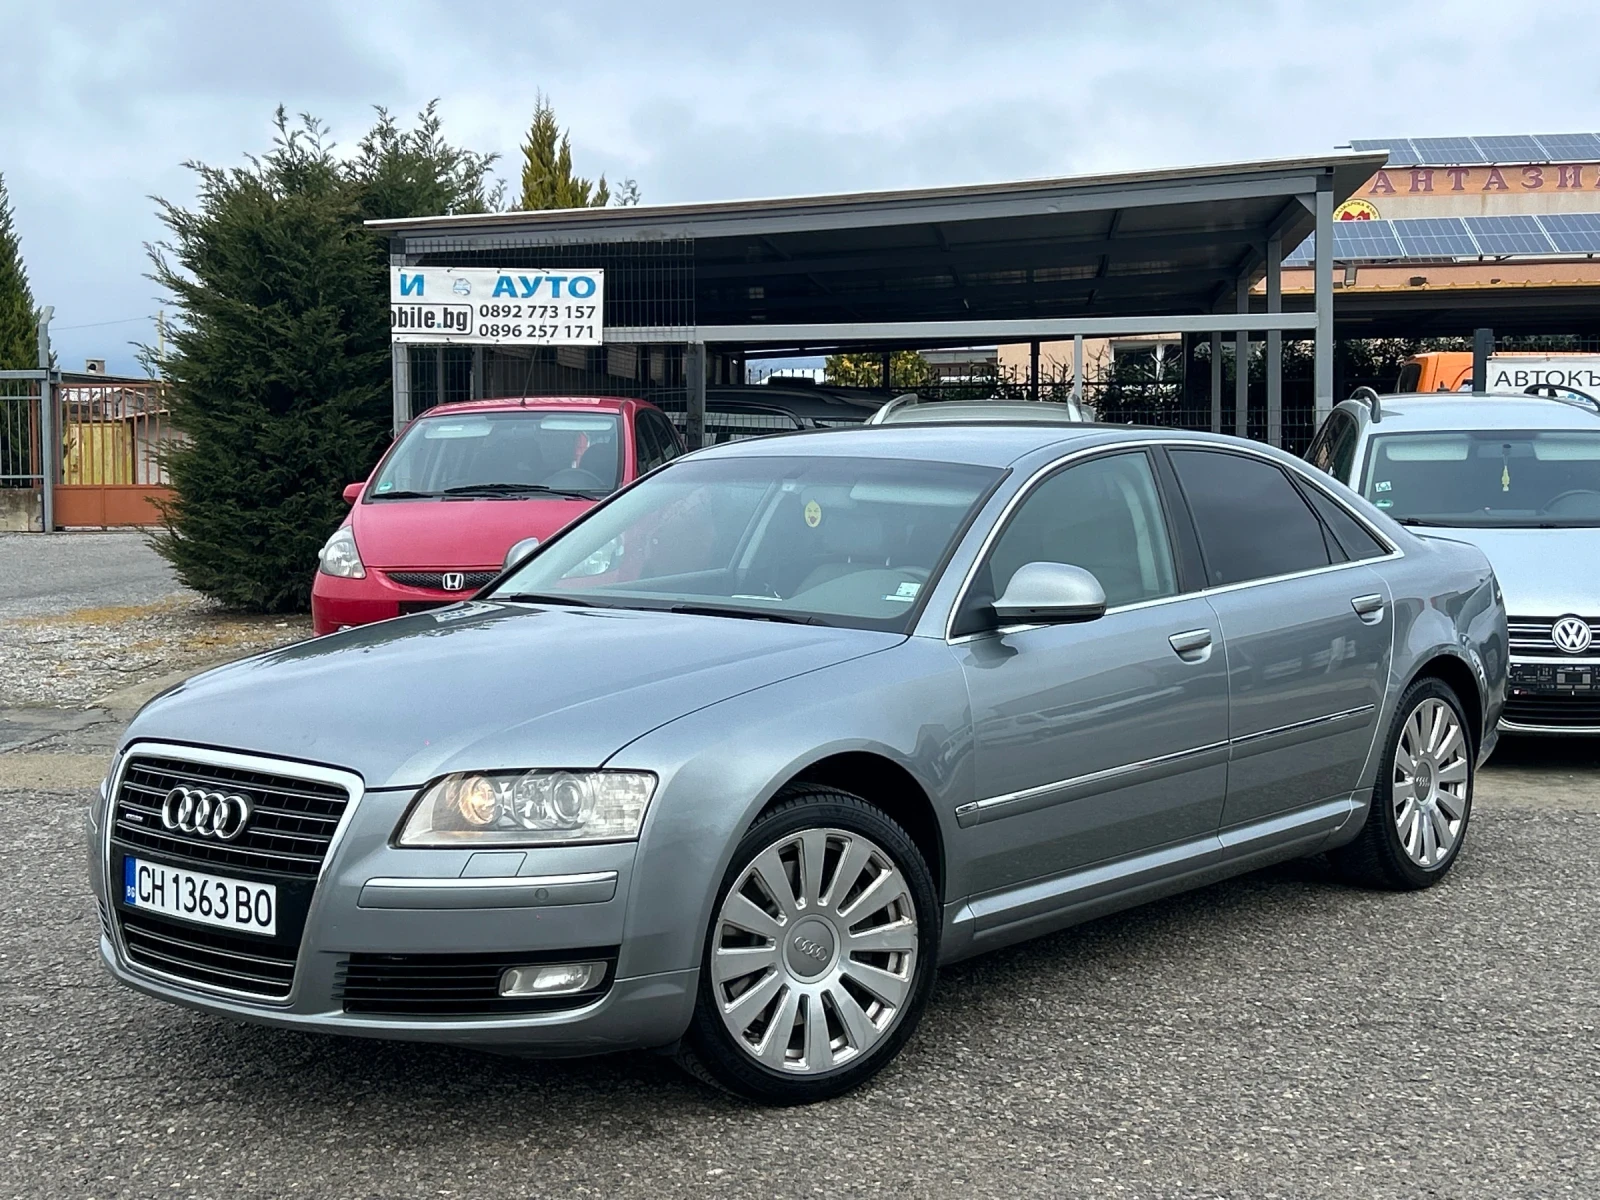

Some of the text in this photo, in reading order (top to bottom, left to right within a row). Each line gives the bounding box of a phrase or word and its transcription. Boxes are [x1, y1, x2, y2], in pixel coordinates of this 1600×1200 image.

[1368, 164, 1600, 194] АНТАЗИ
[400, 273, 597, 299] И АУТО
[479, 304, 596, 319] 0892 773 157
[478, 323, 594, 339] 0896 257 171
